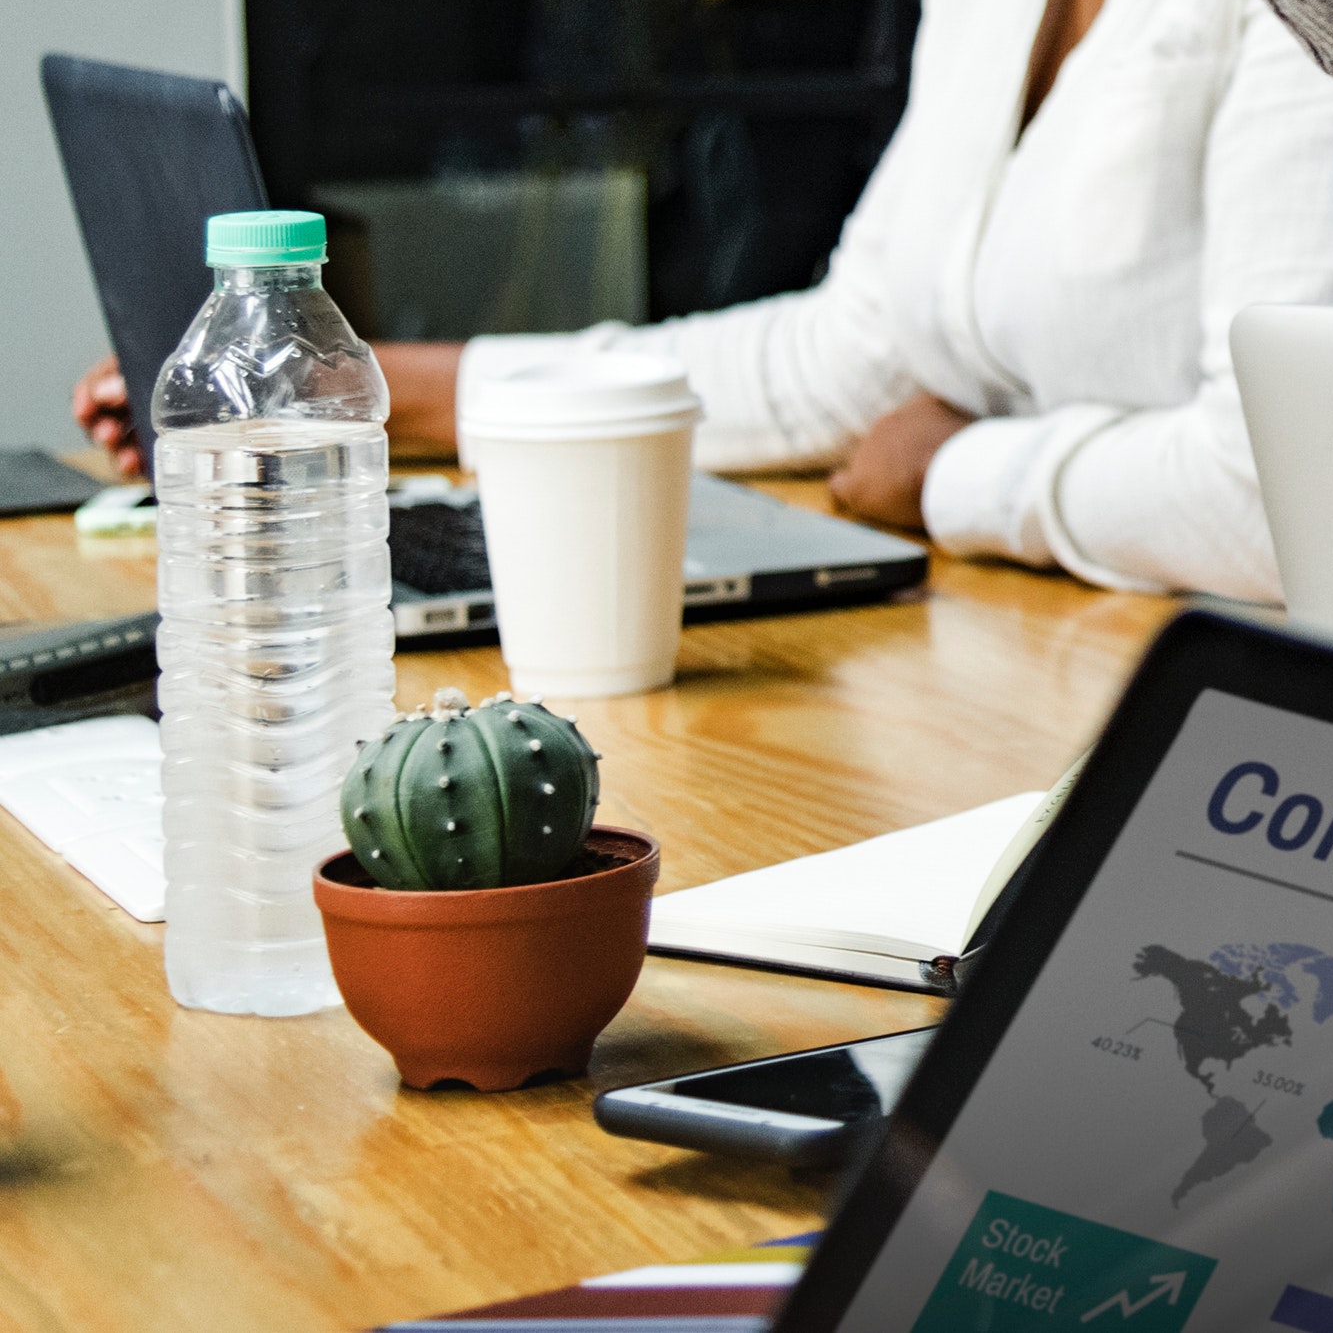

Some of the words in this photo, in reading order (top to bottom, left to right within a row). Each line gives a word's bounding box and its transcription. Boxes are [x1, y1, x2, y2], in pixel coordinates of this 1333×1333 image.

[1091, 1035, 1144, 1060] 40.23%
[982, 1218, 1067, 1268] Stock
[958, 1258, 1065, 1314] Market
